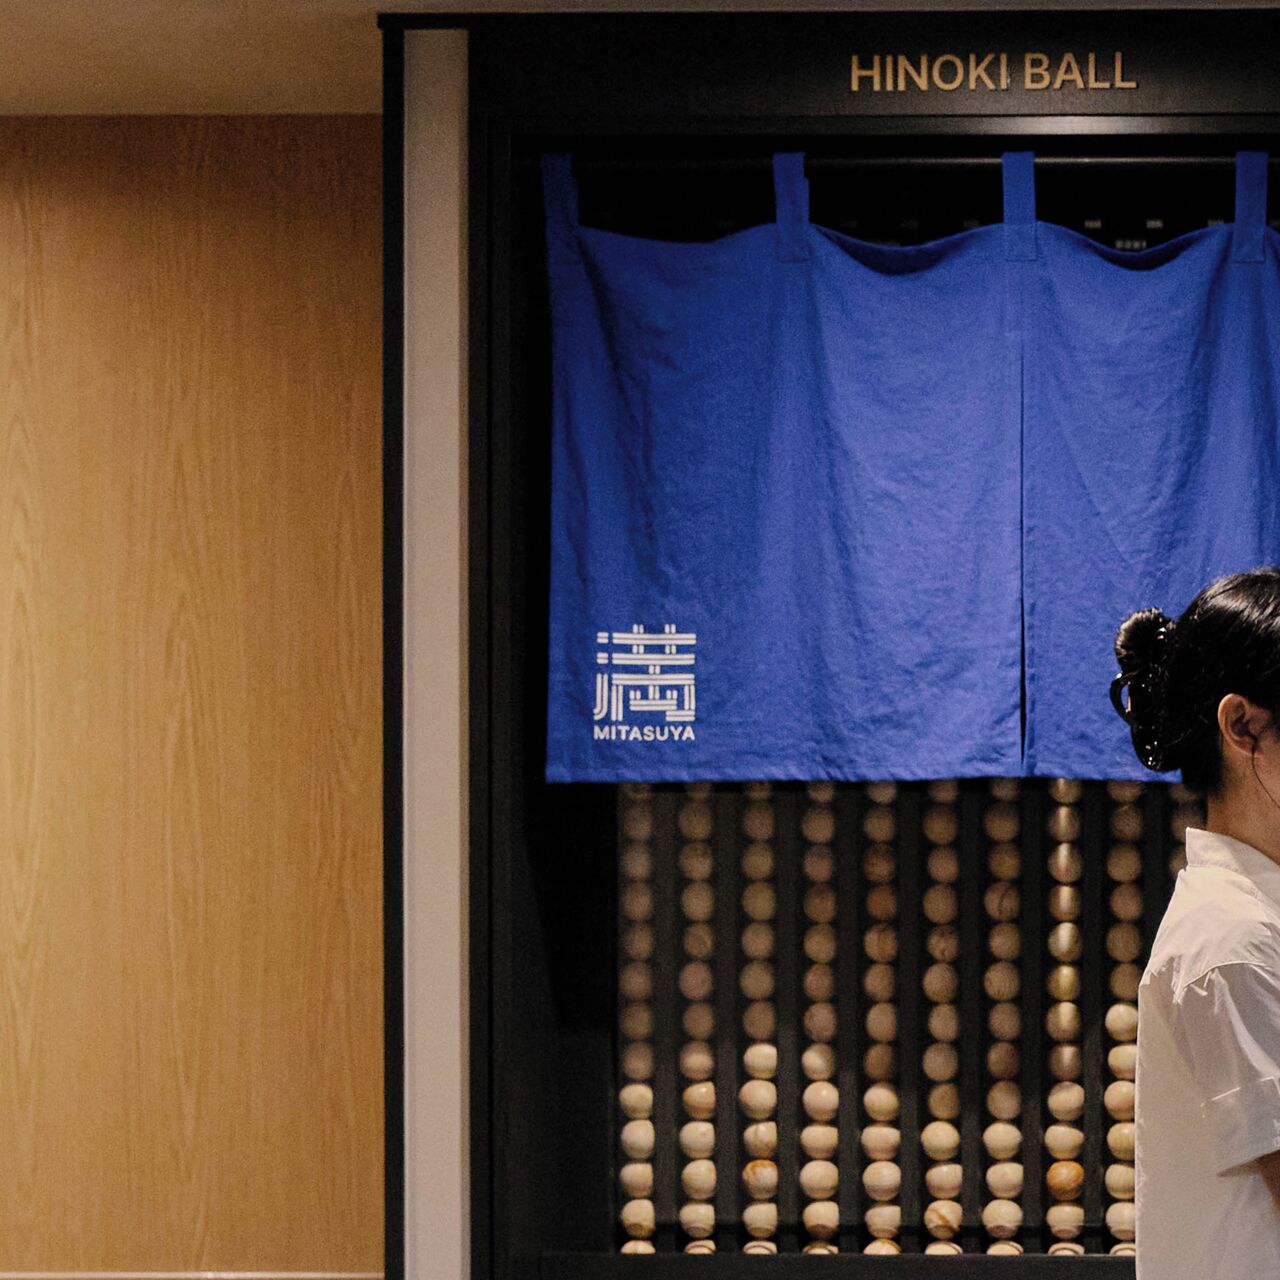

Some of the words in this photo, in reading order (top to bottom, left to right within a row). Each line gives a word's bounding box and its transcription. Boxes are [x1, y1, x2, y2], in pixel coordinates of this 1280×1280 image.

[850, 53, 1008, 92] HINOKI
[1023, 51, 1138, 90] BALL
[593, 725, 695, 741] MITASUYA
